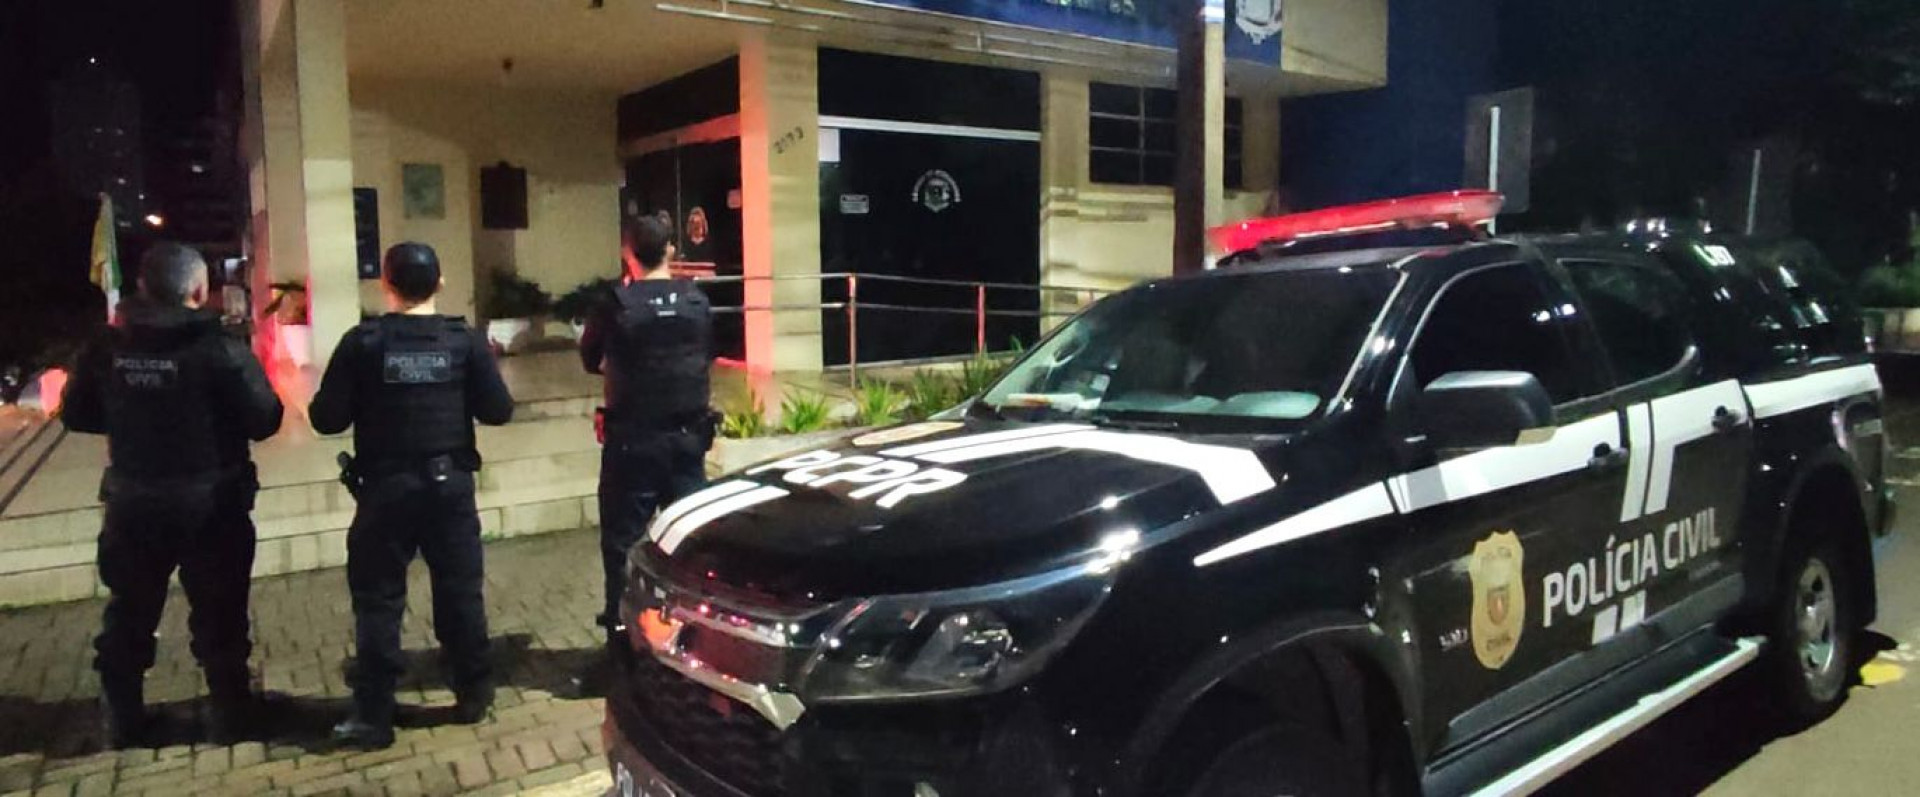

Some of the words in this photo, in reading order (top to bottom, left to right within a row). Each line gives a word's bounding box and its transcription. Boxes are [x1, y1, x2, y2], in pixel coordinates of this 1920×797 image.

[745, 449, 969, 509] PCPR
[1543, 533, 1659, 629] POLÍCIA
[1663, 507, 1721, 570] CIVIL
